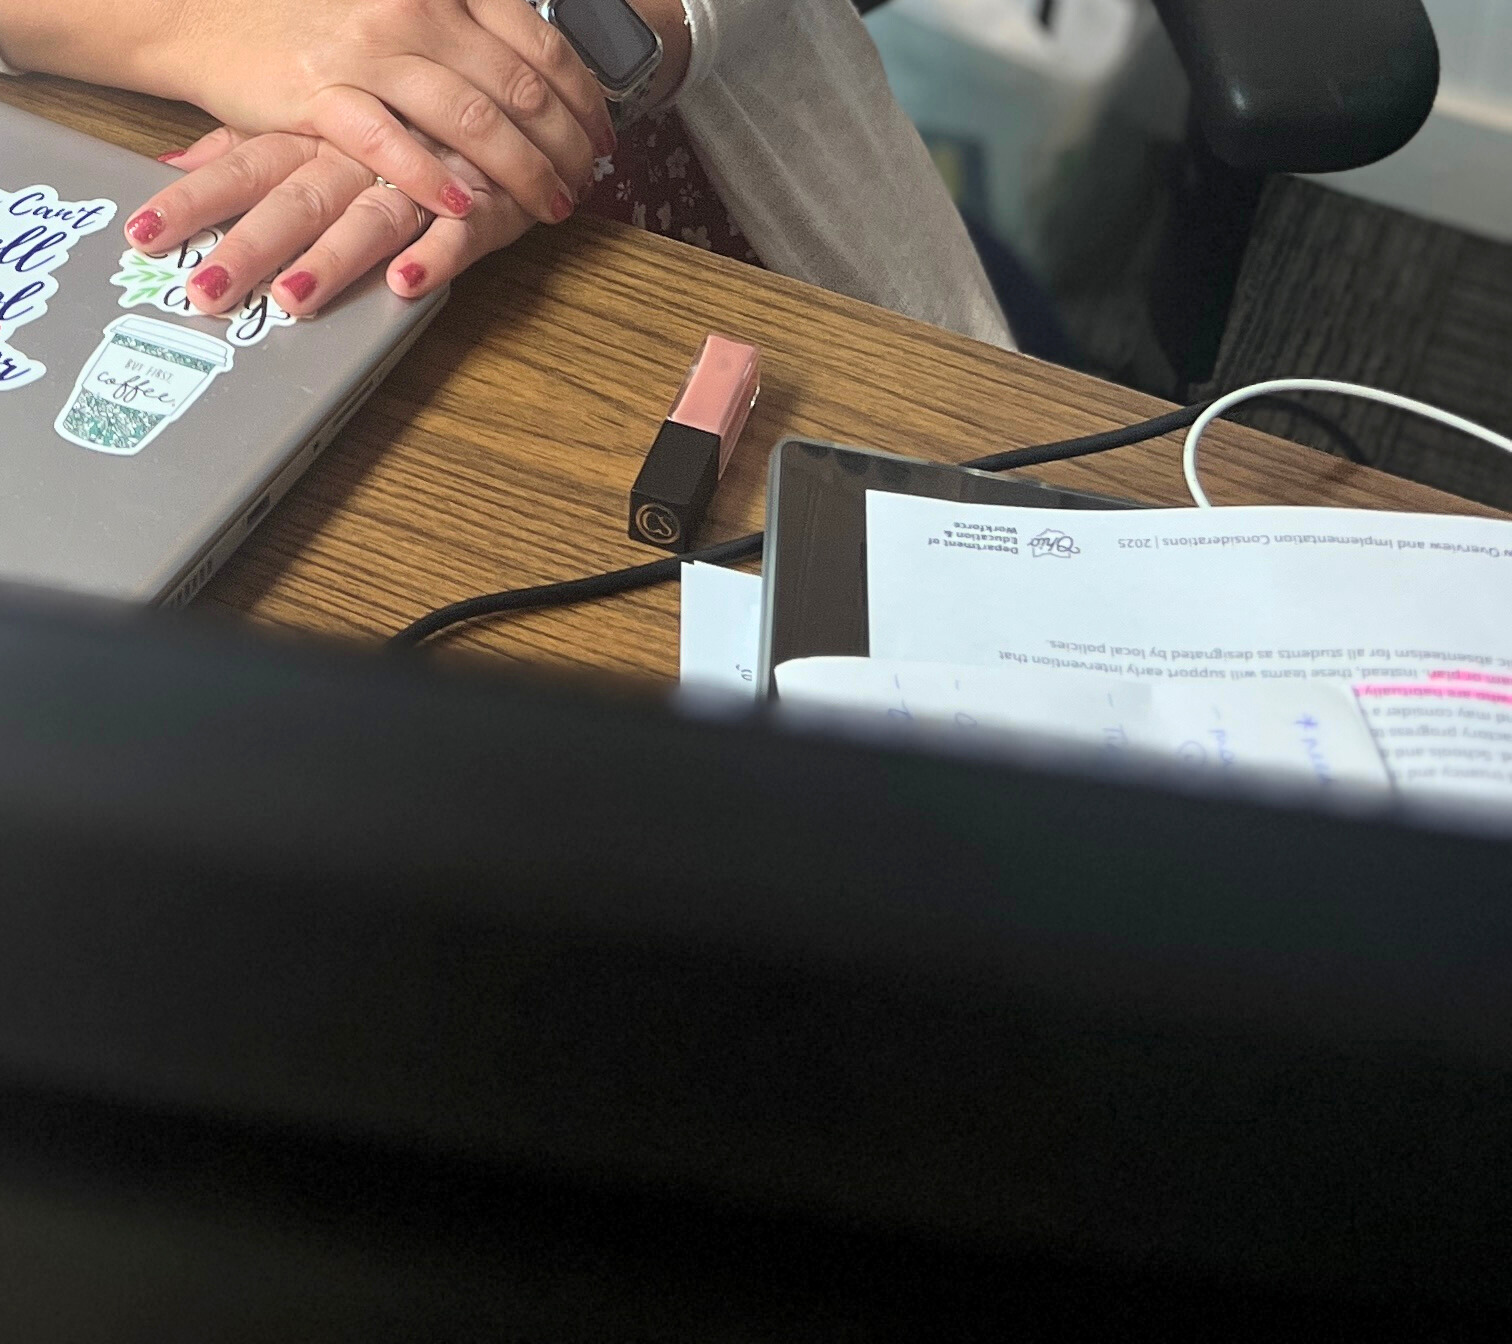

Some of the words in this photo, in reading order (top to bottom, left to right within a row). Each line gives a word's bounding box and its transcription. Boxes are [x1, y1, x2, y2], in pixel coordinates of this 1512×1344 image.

[9, 192, 106, 229] Can't
[124, 358, 144, 372] BUT
[927, 537, 940, 547] of
[955, 531, 1018, 545] Education
[1027, 535, 1081, 555] Ohio
[1117, 537, 1152, 550] 2025
[1162, 533, 1270, 549] Considerations
[1274, 533, 1393, 550] Implementation
[1396, 538, 1425, 550] and
[941, 538, 1019, 554] Department
[1429, 541, 1500, 558] Overview
[1109, 641, 1146, 658] local
[1149, 645, 1168, 659] by
[1171, 647, 1253, 660] designated
[1257, 648, 1273, 659] as
[1278, 647, 1343, 660] students
[1347, 648, 1365, 660] all
[1368, 647, 1391, 660] for
[998, 650, 1028, 664] that
[1395, 649, 1492, 666] absenteeism
[1031, 655, 1123, 677] intervention
[1126, 662, 1164, 678] early
[1168, 666, 1226, 679] support
[1311, 667, 1353, 679] these
[1230, 668, 1257, 681] will
[1261, 668, 1307, 680] teams
